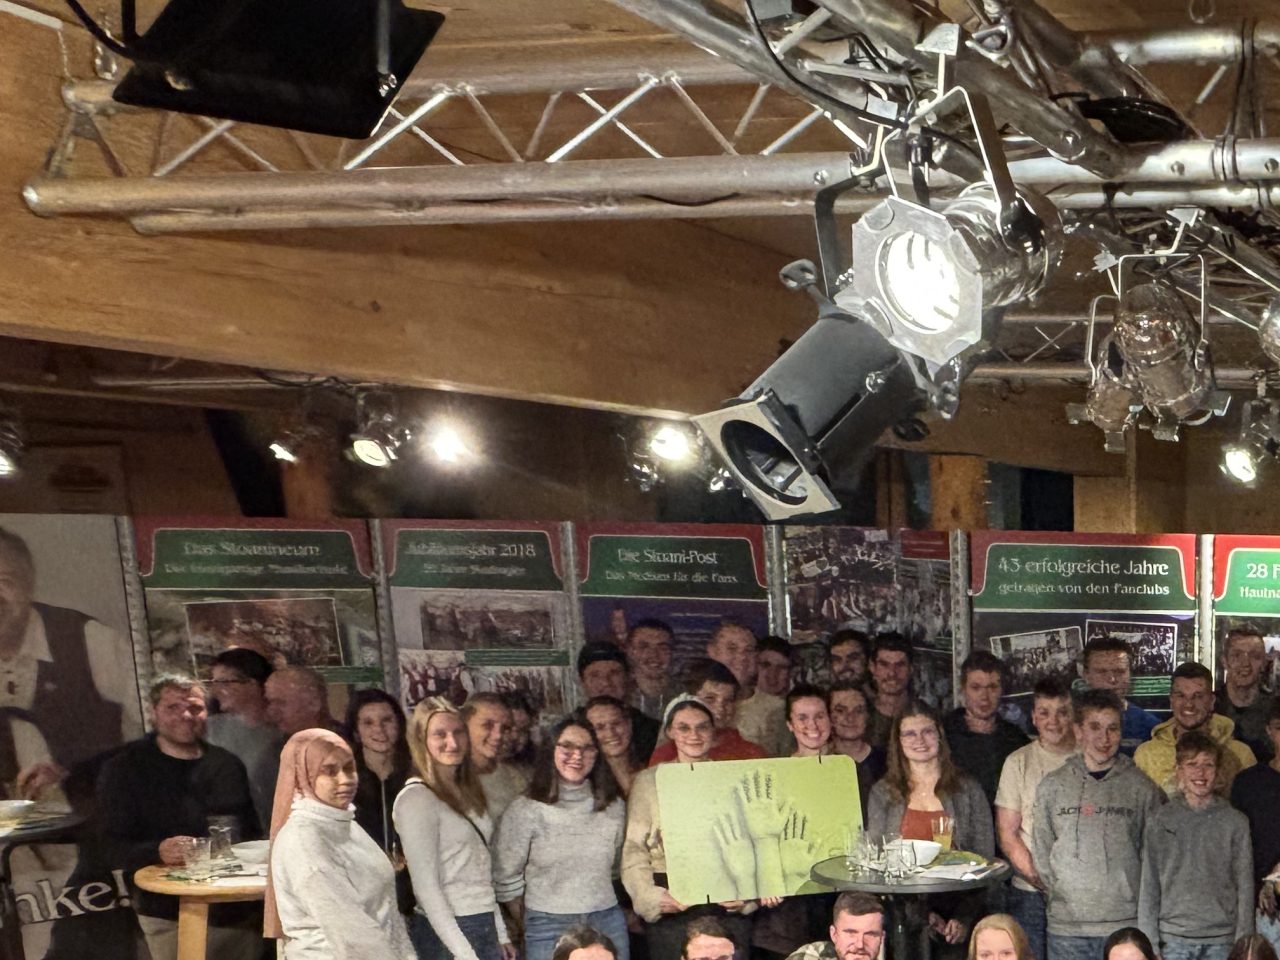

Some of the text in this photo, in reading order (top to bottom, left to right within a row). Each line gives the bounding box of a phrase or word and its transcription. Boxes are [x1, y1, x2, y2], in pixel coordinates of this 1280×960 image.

[500, 543, 537, 559] 2018
[998, 556, 1169, 577] 43 erfolgreiche Jahre
[1245, 563, 1268, 579] 28
[1058, 585, 1082, 595] von
[1085, 583, 1110, 595] den
[1113, 583, 1171, 596] Fanclubs
